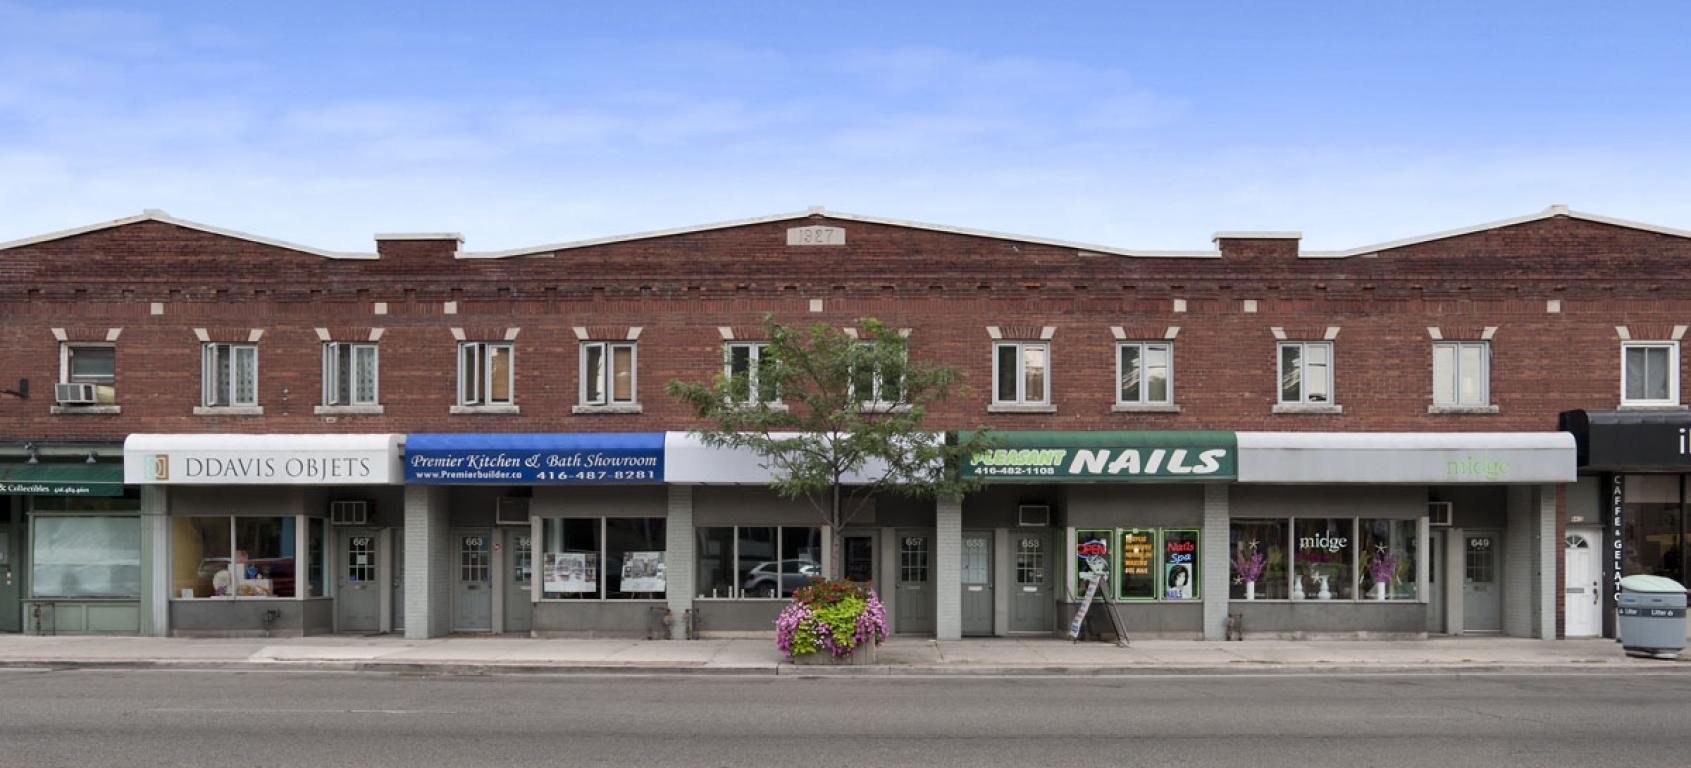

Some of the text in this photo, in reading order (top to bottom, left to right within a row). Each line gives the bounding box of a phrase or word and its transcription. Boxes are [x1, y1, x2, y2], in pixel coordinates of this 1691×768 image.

[799, 229, 834, 243] 1927
[411, 452, 658, 470] Premier Kitchen & Bath Showroom
[970, 449, 1227, 474] PLEASANT NAILS
[1446, 450, 1511, 481] midge
[185, 457, 371, 480] DDAVIS OBJETS
[536, 470, 655, 480] 416-487-8281
[8, 484, 50, 493] Collectibles
[353, 537, 370, 546] 667
[466, 537, 483, 546] 663
[905, 536, 922, 546] 657
[1167, 541, 1195, 552] Nails
[1299, 529, 1348, 553] midge
[1470, 538, 1489, 548] 649
[1076, 543, 1107, 556] OPEN
[1170, 553, 1192, 564] Spa
